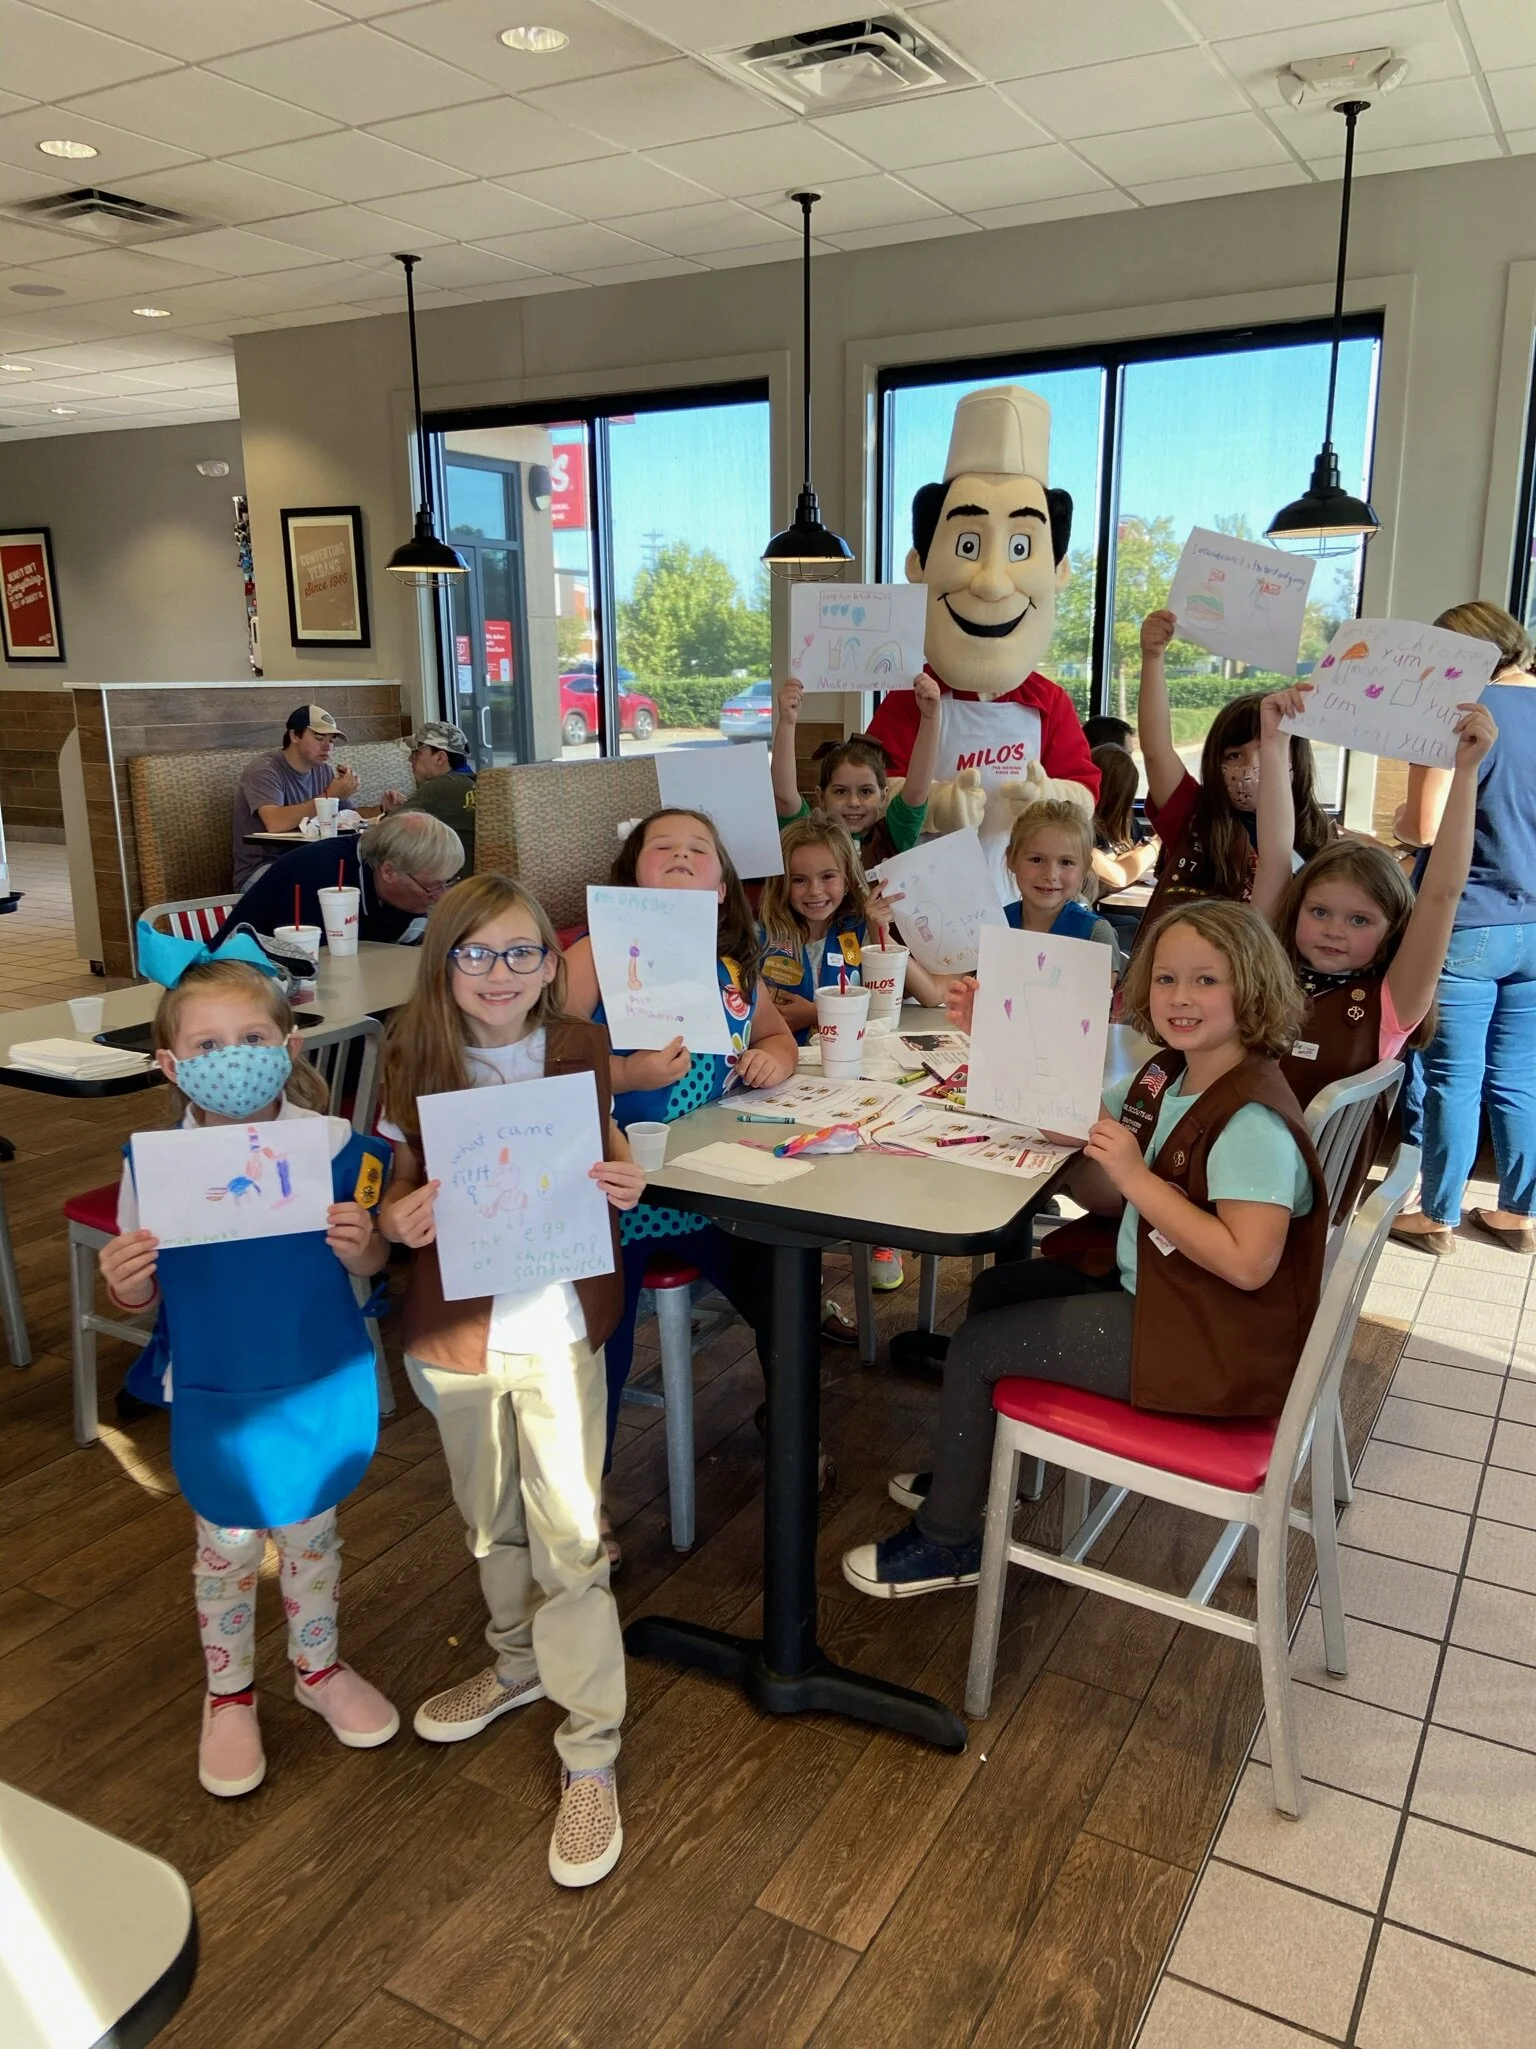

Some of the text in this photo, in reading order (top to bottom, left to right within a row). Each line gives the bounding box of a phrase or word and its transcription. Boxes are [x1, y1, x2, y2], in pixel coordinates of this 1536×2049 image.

[300, 542, 345, 567] CONVERTING
[307, 559, 342, 581] VEGANS
[304, 572, 348, 598] Since 1946
[956, 742, 1025, 771] MILO'S
[496, 1123, 556, 1140] came
[452, 1163, 491, 1189] first
[524, 1220, 565, 1242] egg
[474, 1257, 493, 1271] or
